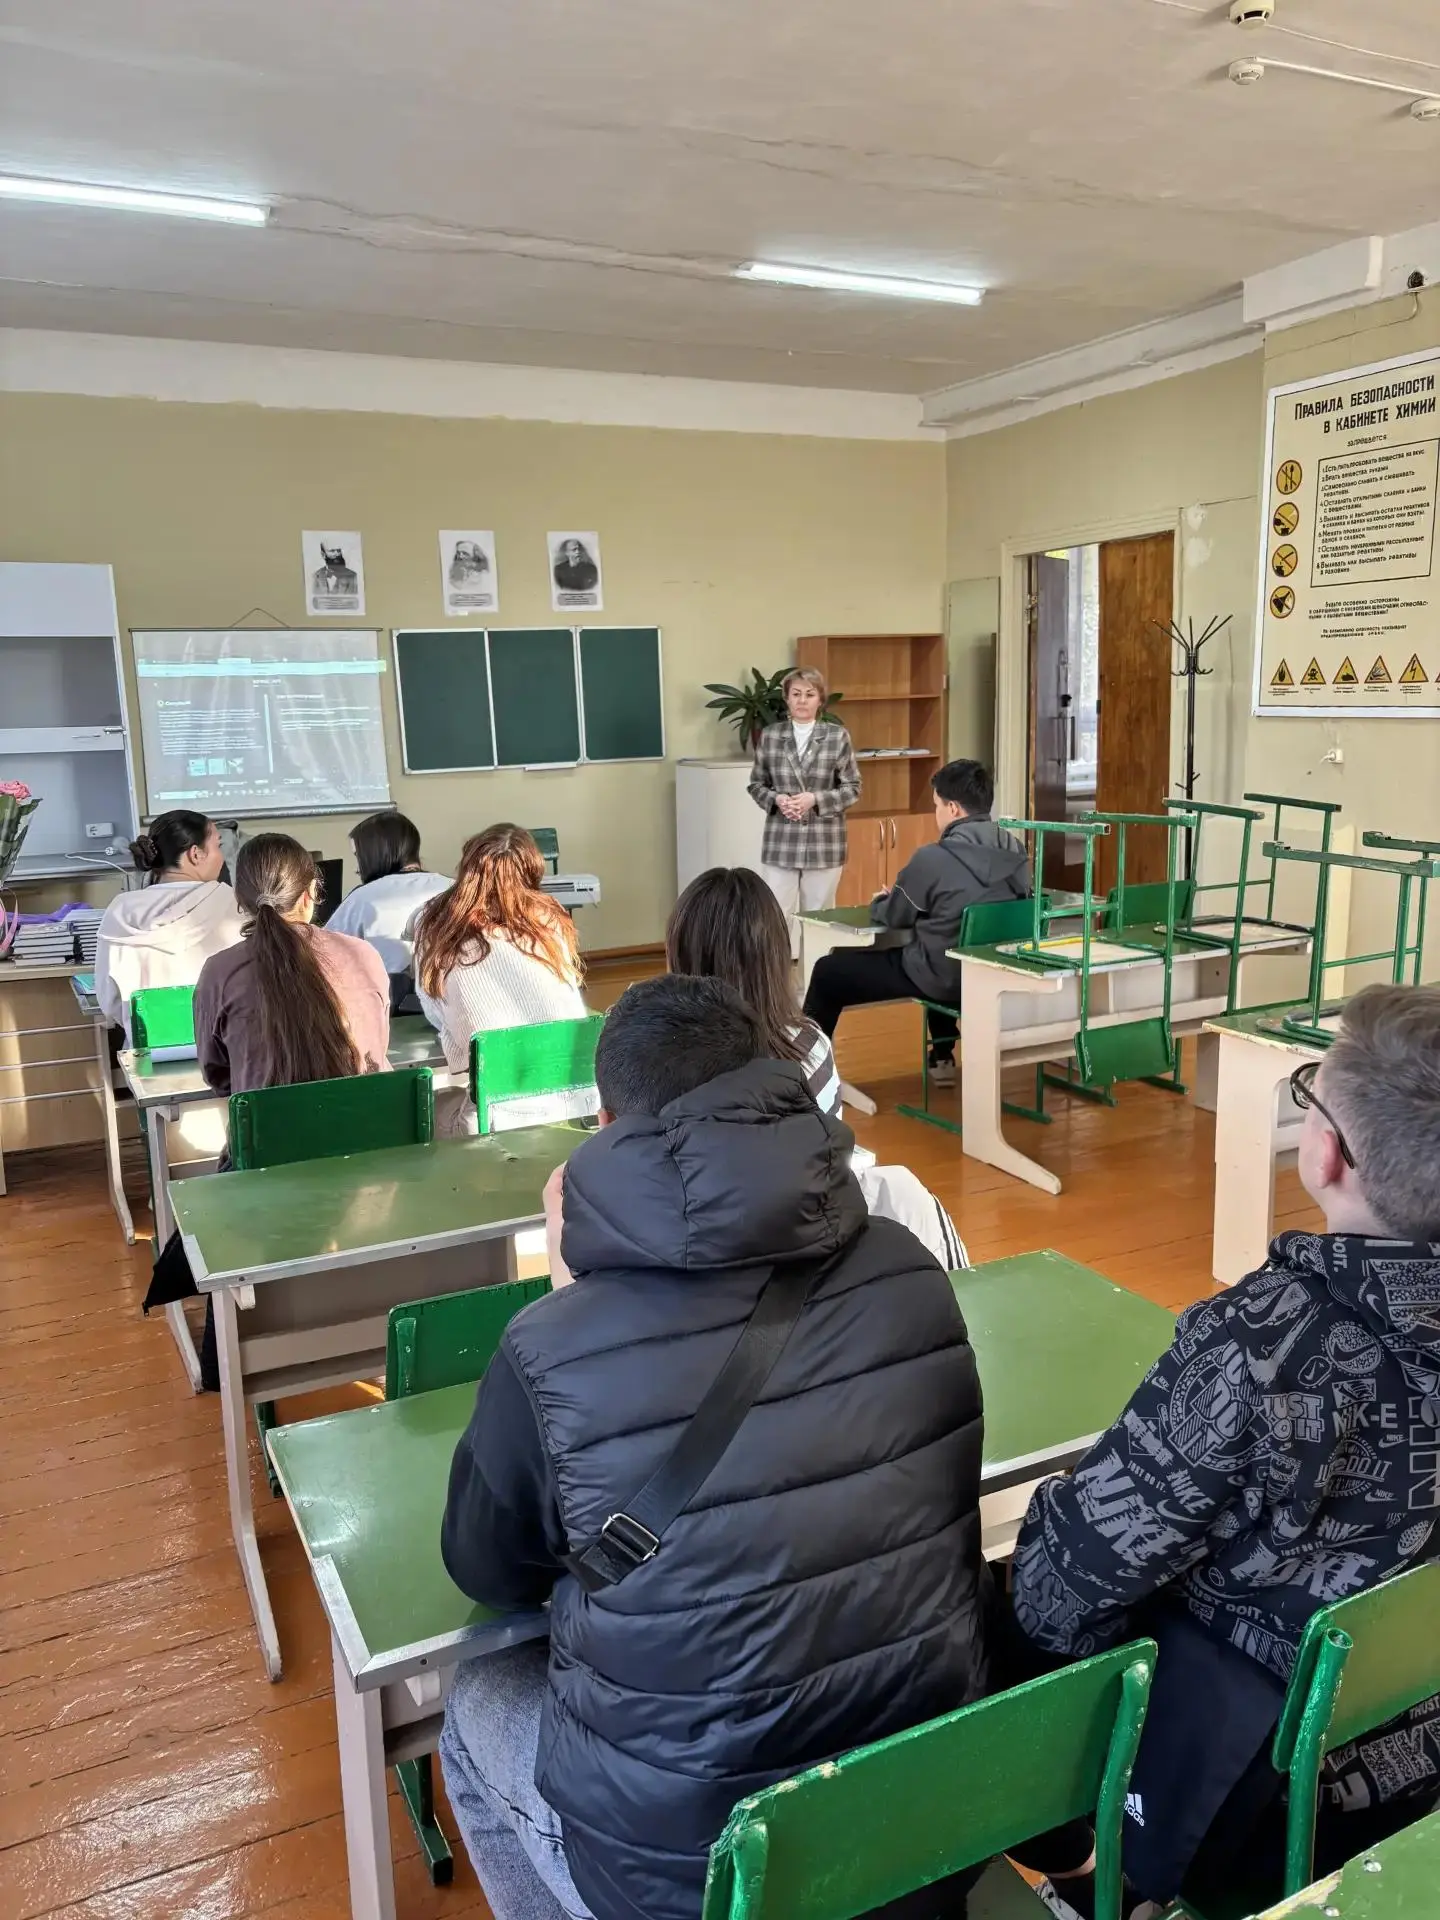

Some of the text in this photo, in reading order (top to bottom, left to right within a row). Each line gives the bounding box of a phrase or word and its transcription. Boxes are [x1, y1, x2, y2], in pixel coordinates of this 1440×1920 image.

[1295, 375, 1435, 420] ПРАВИЛА БЕЗОПАСНОСТИ
[1323, 397, 1437, 433] В КАБИНЕТЕ ХИМИИ
[1166, 1469, 1211, 1514] NIKE
